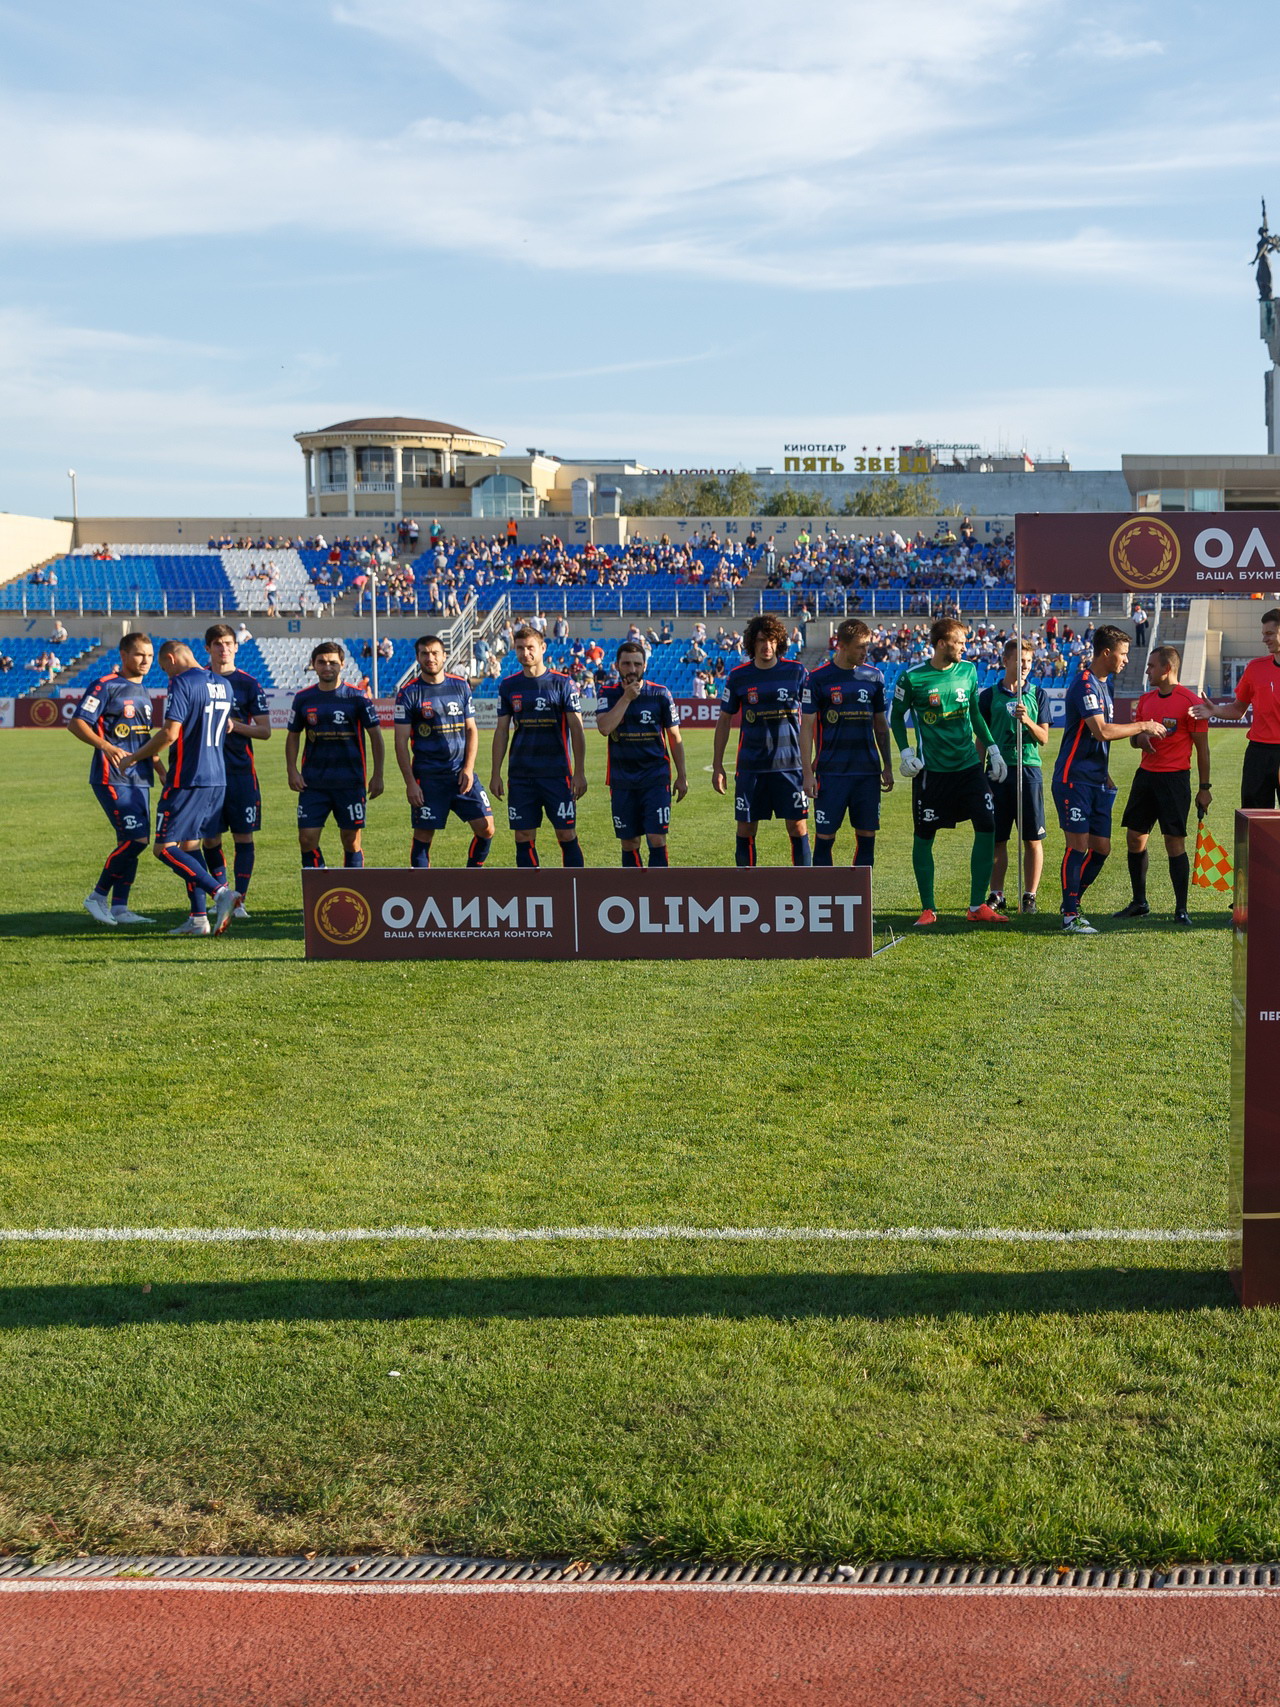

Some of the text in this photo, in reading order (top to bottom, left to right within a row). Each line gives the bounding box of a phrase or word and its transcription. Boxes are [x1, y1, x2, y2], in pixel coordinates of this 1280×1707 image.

[784, 444, 847, 452] КИНОТЕАТР
[784, 456, 930, 473] ПЯТЬ ЗВЕЗД
[1196, 571, 1234, 580] ВАША
[205, 700, 231, 747] 17
[479, 790, 490, 807] 8
[347, 803, 364, 821] 19
[557, 801, 575, 820] 44
[656, 806, 670, 824] 10
[382, 896, 554, 929] ОЛИМП
[598, 896, 863, 934] OLIMP.BET
[418, 930, 501, 938] БУКМЕКЕРСКАЯ
[504, 930, 553, 938] КОНТОРА
